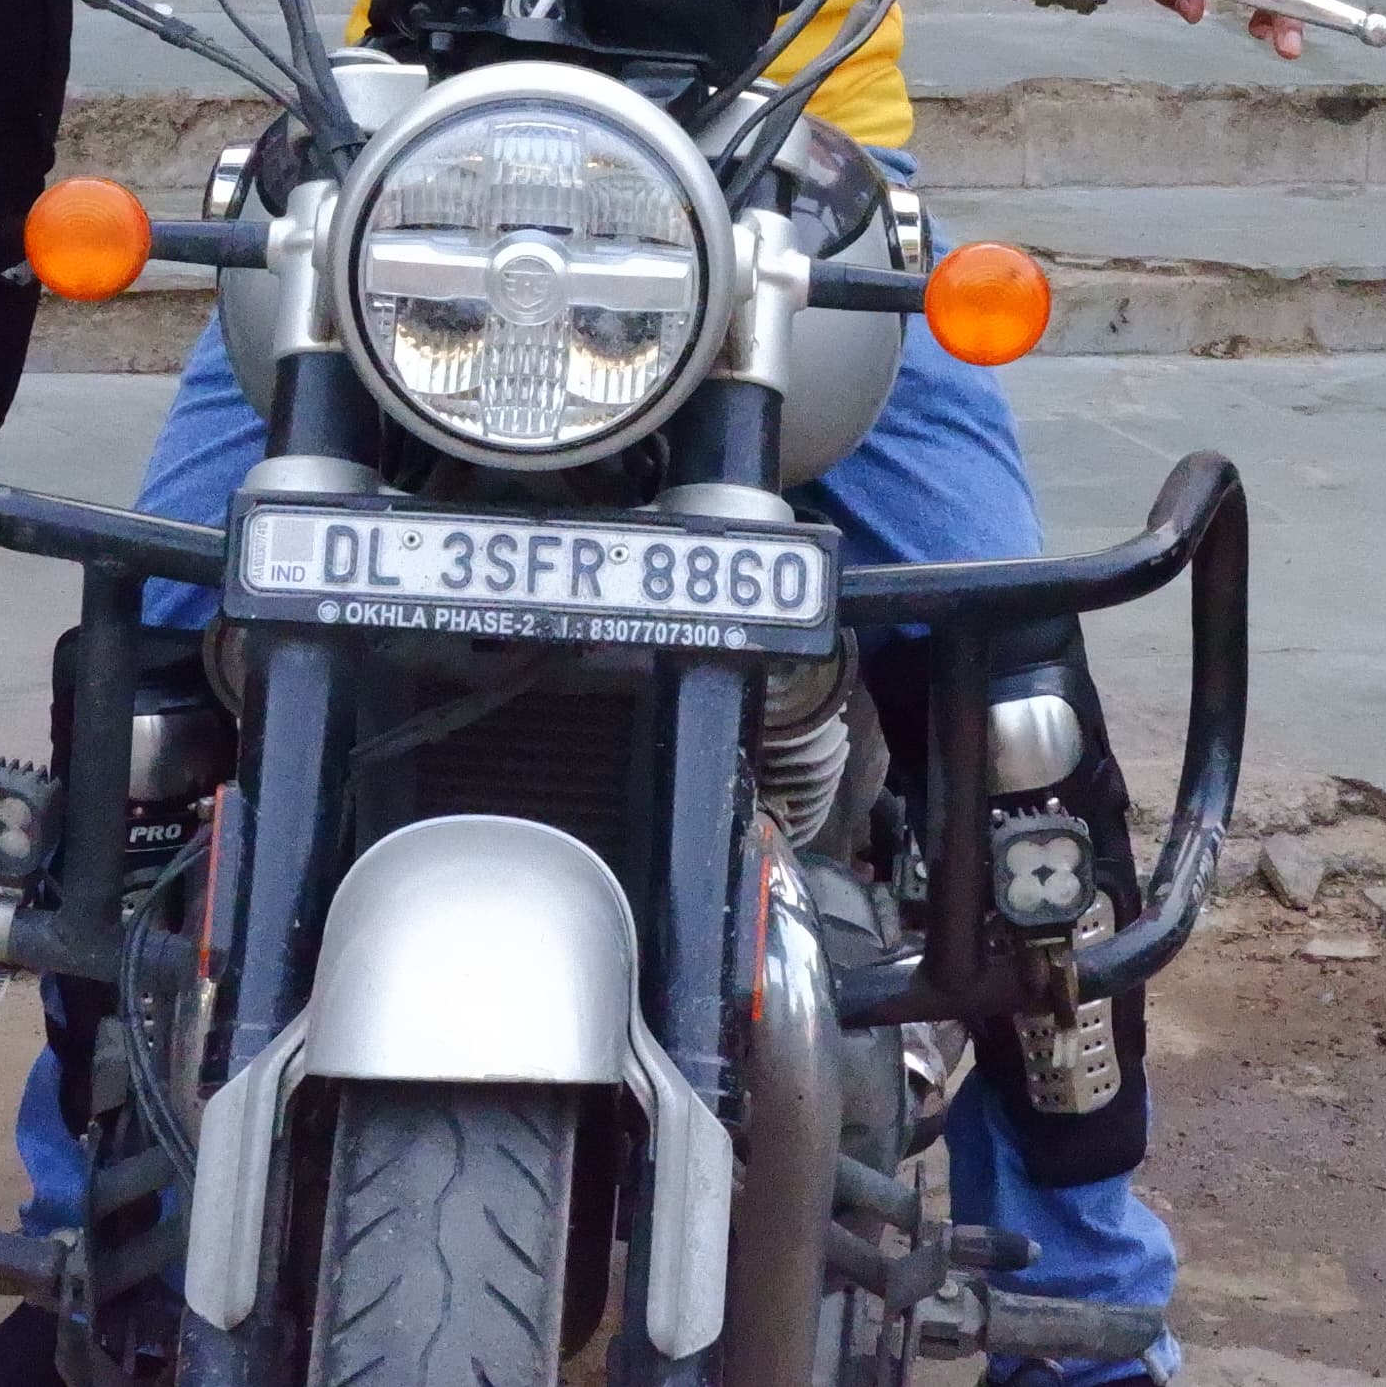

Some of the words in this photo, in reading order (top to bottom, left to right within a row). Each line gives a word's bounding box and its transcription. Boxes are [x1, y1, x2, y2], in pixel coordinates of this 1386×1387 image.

[271, 565, 306, 582] IND
[324, 524, 401, 586] DL
[441, 531, 606, 598] 3SFR
[642, 543, 807, 609] 8860
[345, 602, 427, 630] OKHLA
[434, 608, 536, 637] PHASE-2
[590, 617, 721, 647] 8307707300
[129, 823, 182, 844] PRO
